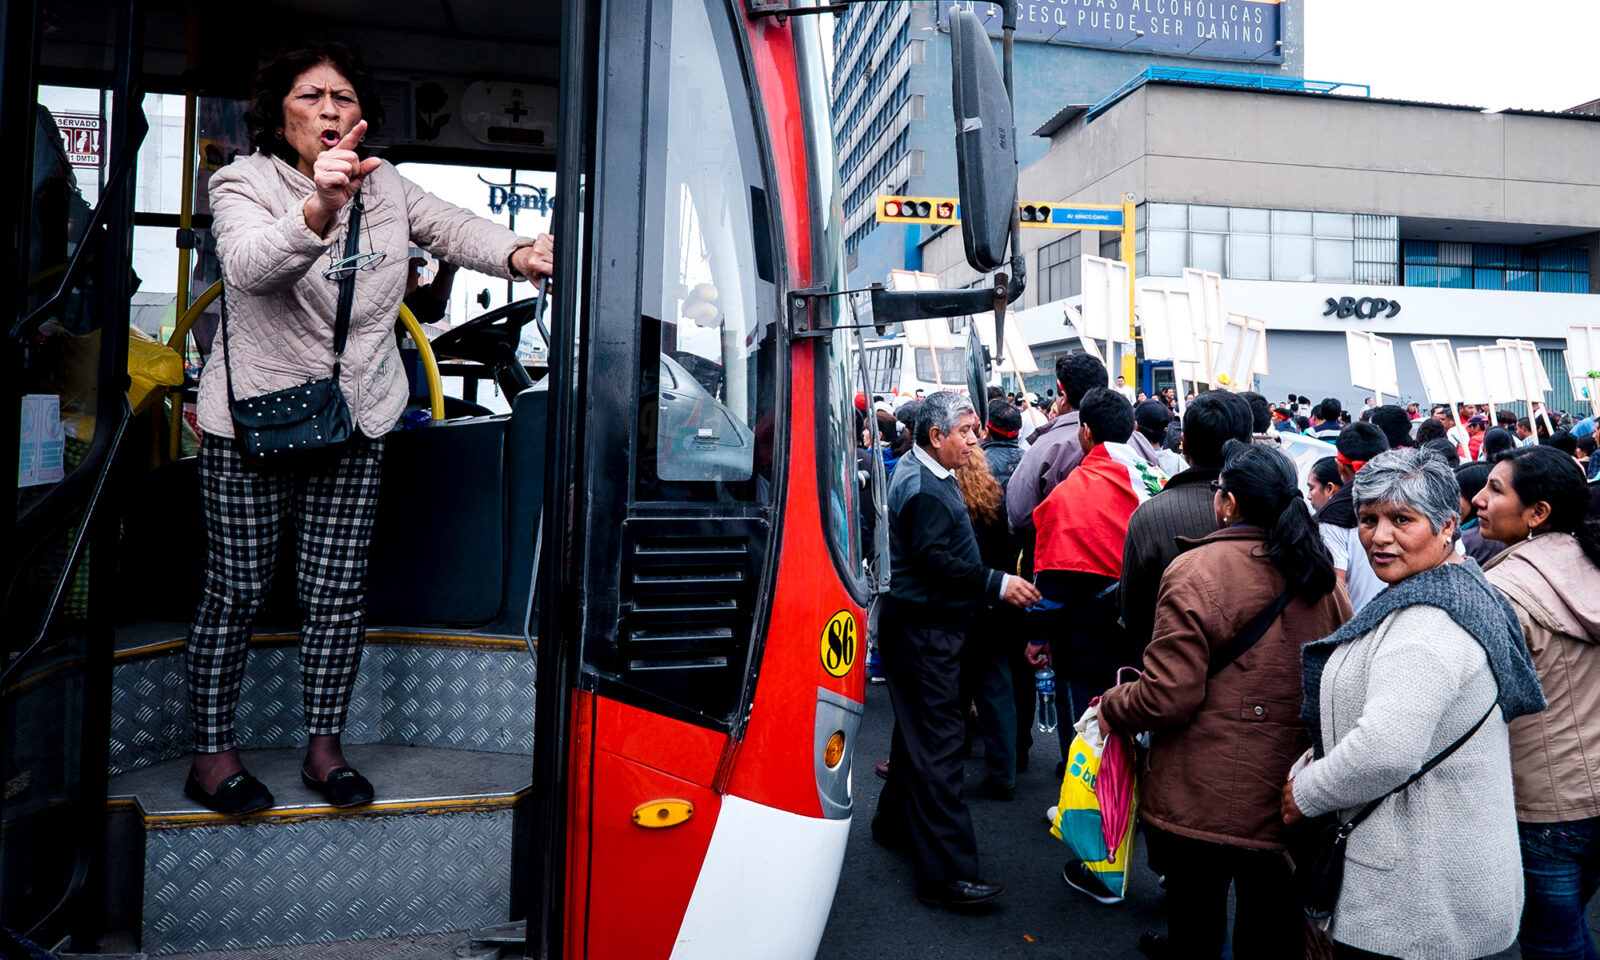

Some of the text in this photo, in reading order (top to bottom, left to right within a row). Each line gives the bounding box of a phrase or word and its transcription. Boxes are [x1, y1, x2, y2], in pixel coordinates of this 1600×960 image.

[990, 2, 1064, 25] ECESO
[1078, 9, 1137, 31] PUEDE
[1150, 17, 1183, 36] SER
[1197, 21, 1263, 43] DAÑINO
[940, 207, 950, 215] 55
[1337, 296, 1389, 319] BCP
[827, 616, 854, 669] 86
